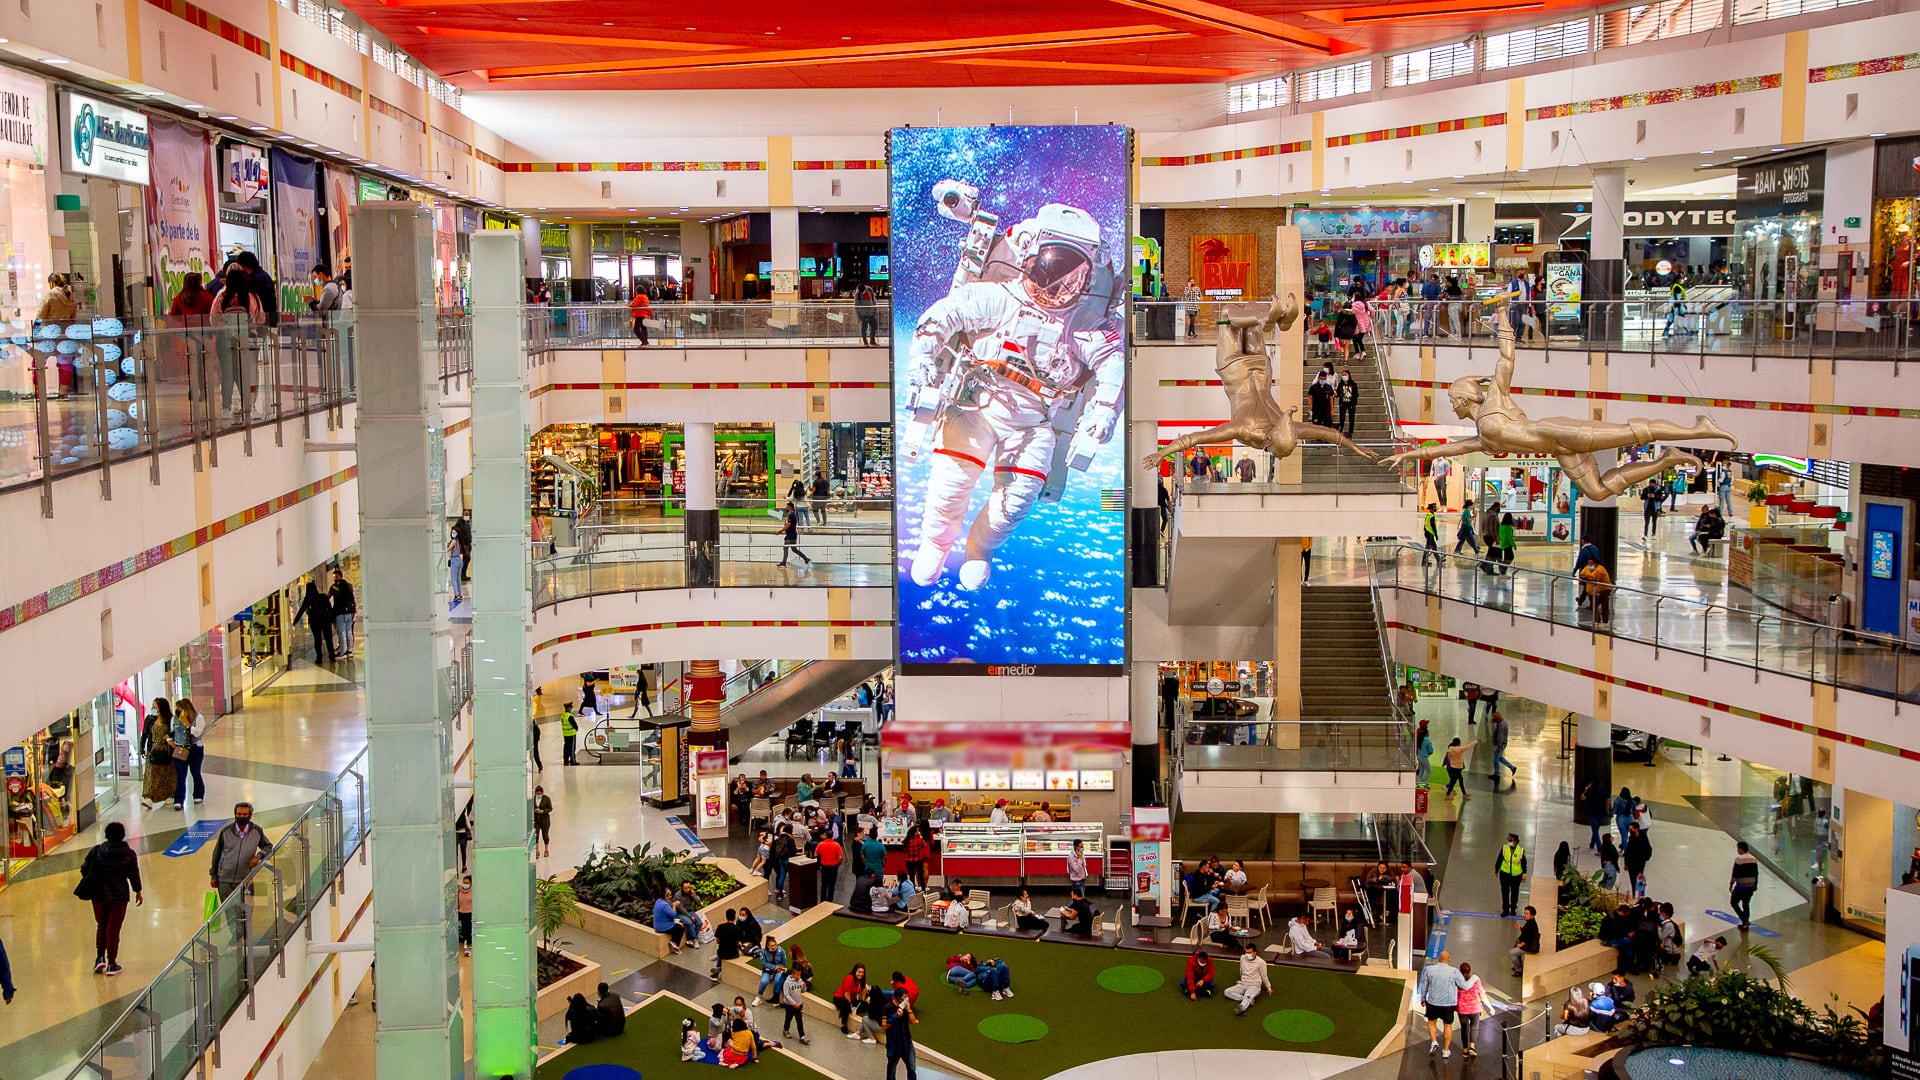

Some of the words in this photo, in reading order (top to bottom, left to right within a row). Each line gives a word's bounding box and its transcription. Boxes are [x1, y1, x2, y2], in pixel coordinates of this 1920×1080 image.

[0, 91, 19, 117] IENDA
[22, 96, 29, 119] DE
[160, 220, 168, 238] Sé
[169, 223, 185, 243] parte
[186, 225, 194, 240] de
[194, 226, 200, 241] la
[1324, 221, 1374, 238] Crazy
[1204, 262, 1246, 289] BW
